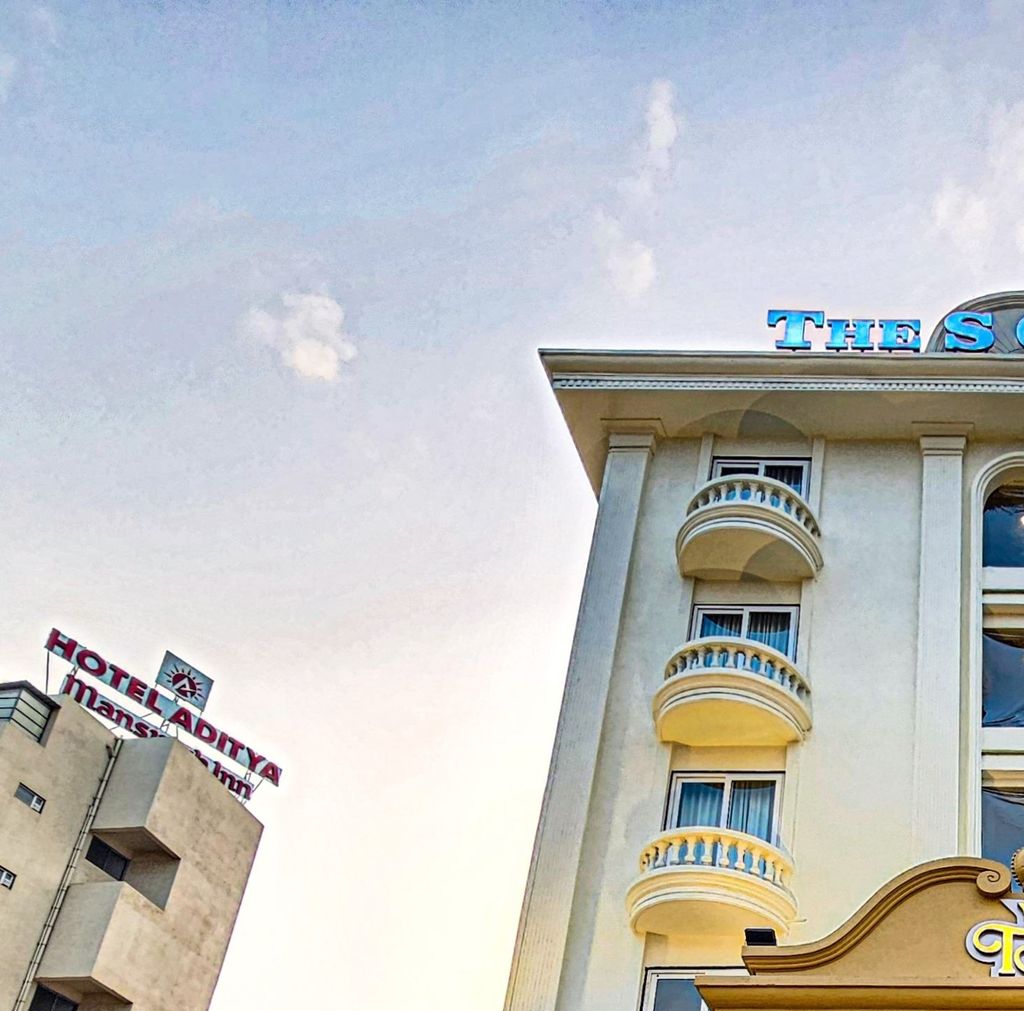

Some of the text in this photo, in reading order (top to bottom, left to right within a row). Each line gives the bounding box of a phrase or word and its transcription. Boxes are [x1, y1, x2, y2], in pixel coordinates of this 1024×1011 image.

[767, 309, 921, 351] THE
[944, 311, 995, 352] S
[47, 628, 280, 787] HOTEL ADITYA
